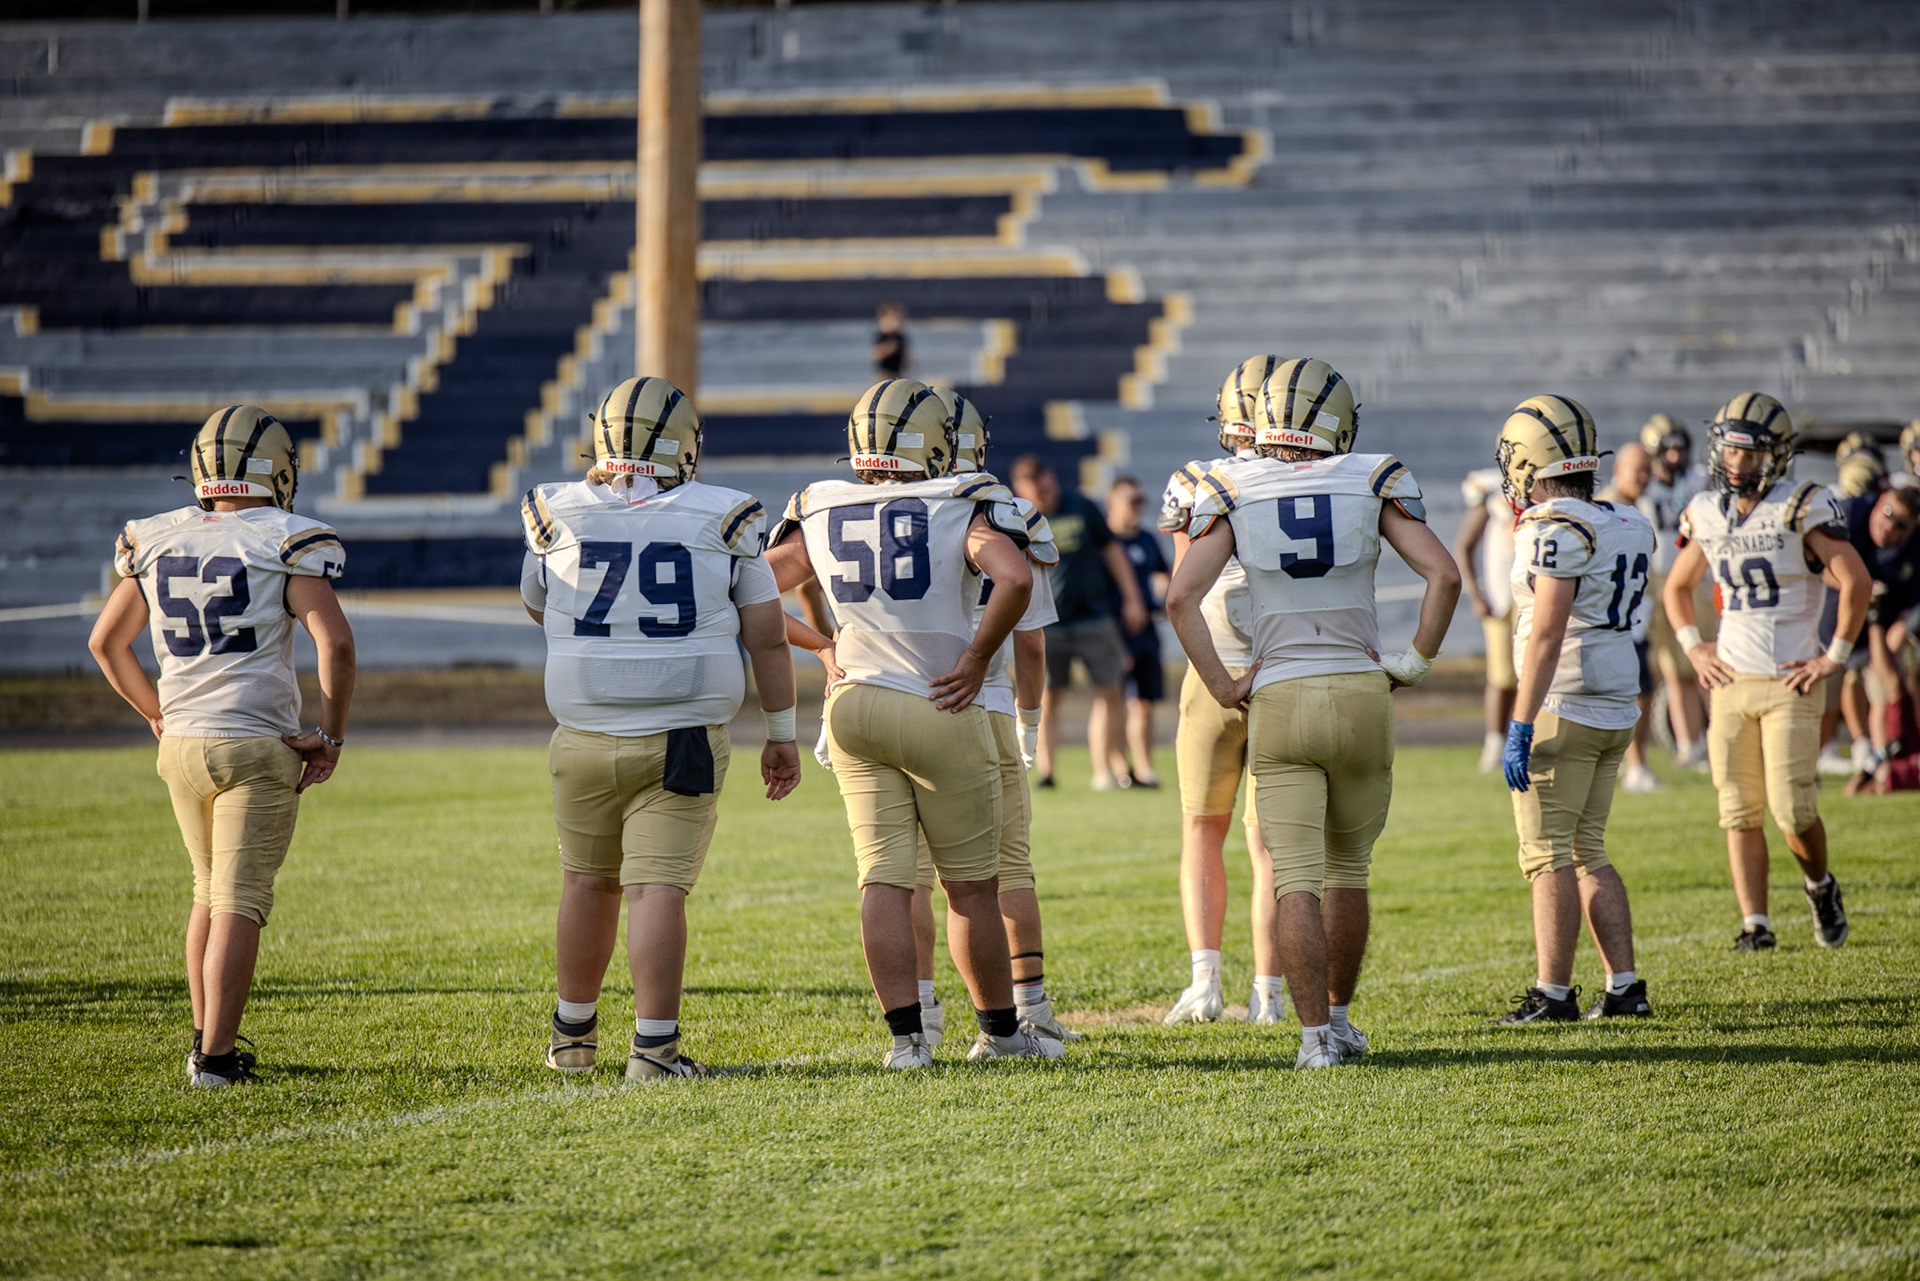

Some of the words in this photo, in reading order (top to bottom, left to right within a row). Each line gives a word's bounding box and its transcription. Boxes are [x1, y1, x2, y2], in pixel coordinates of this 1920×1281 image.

[1265, 431, 1313, 445] Riddell
[606, 461, 655, 475] Riddell
[855, 457, 899, 469] Riddell
[1562, 459, 1598, 471] Riddel
[201, 483, 249, 496] Riddell
[828, 497, 931, 603] 58
[1277, 494, 1335, 579] 9
[1531, 537, 1558, 569] 12
[573, 541, 697, 638] 79
[1596, 552, 1649, 632] 12
[1720, 557, 1780, 610] 10
[156, 556, 258, 657] 52
